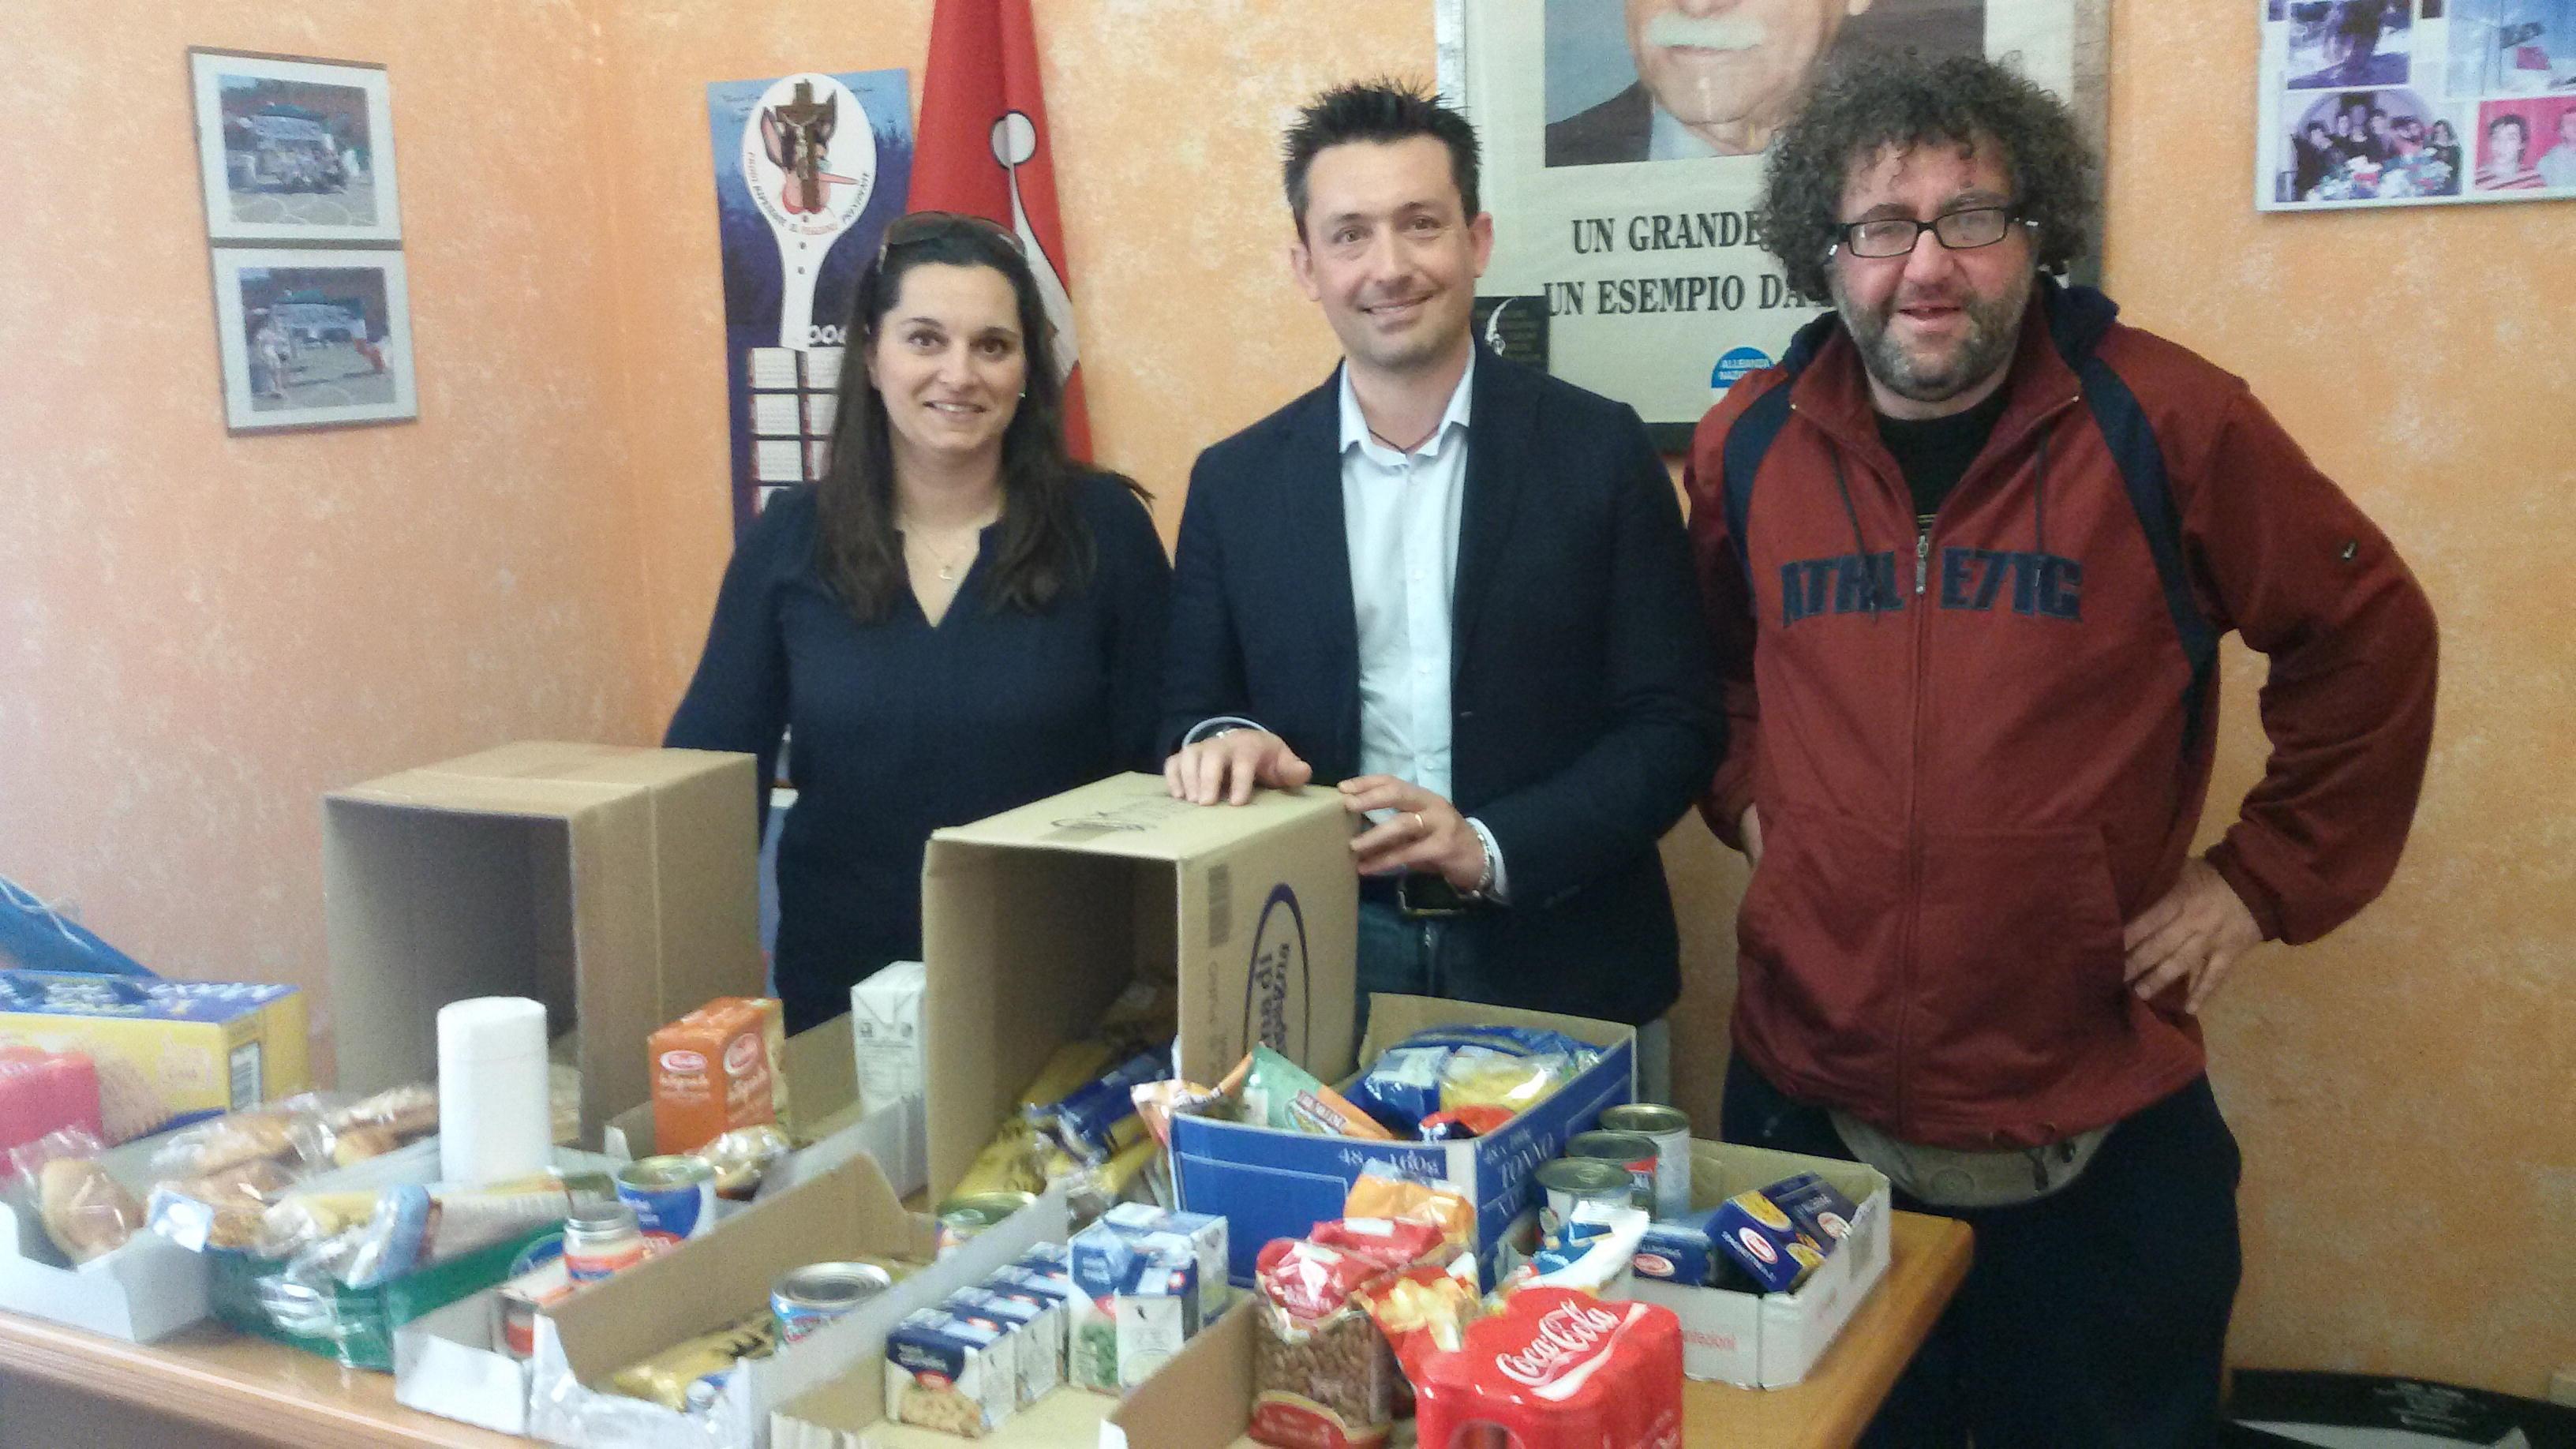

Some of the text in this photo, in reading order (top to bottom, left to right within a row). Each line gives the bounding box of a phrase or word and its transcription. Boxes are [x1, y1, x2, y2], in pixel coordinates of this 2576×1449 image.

[1572, 211, 1765, 254] UN GRANDE
[1544, 282, 1585, 316] UN
[1597, 275, 1746, 314] ESEMPIO
[1496, 1298, 1621, 1387] Coca-Cola
